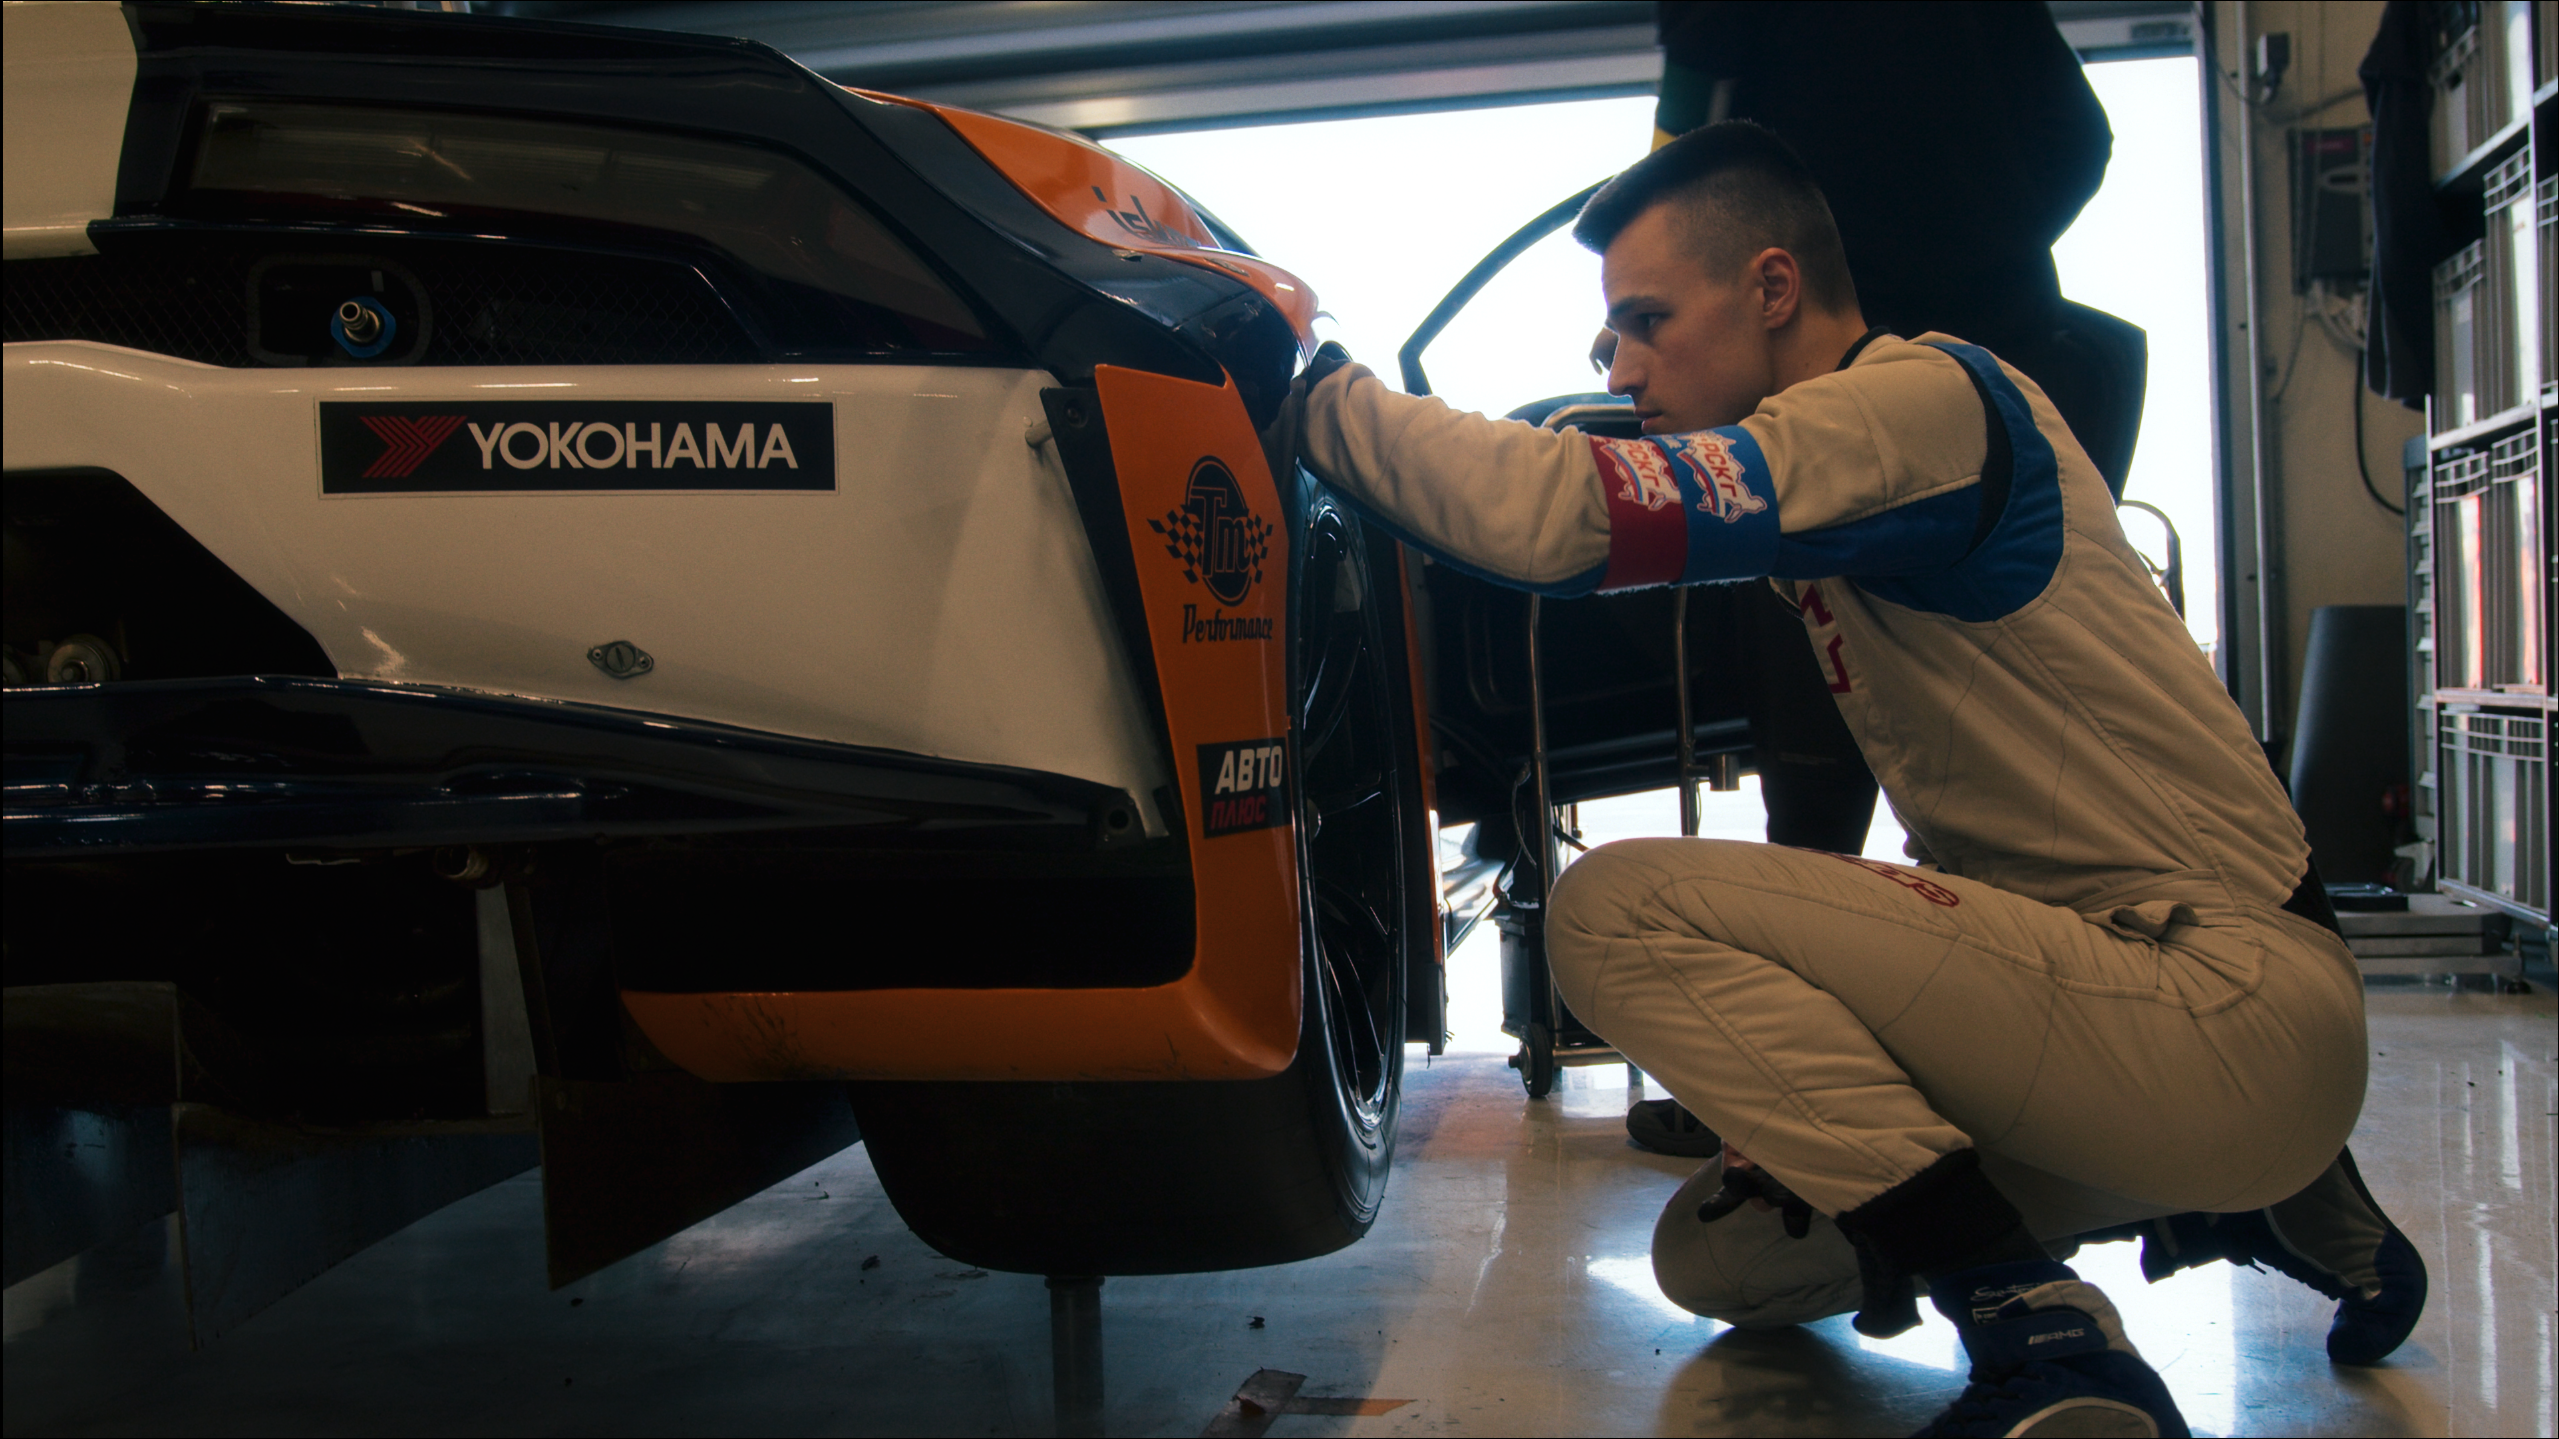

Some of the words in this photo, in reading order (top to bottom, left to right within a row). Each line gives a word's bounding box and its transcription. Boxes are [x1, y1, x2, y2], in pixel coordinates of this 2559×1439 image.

[467, 422, 799, 469] YOKOHAMA
[1697, 443, 1737, 498] РСКГ
[1182, 604, 1273, 644] Performance
[1214, 746, 1283, 795] АВТО
[1210, 795, 1267, 831] ПЛЮС
